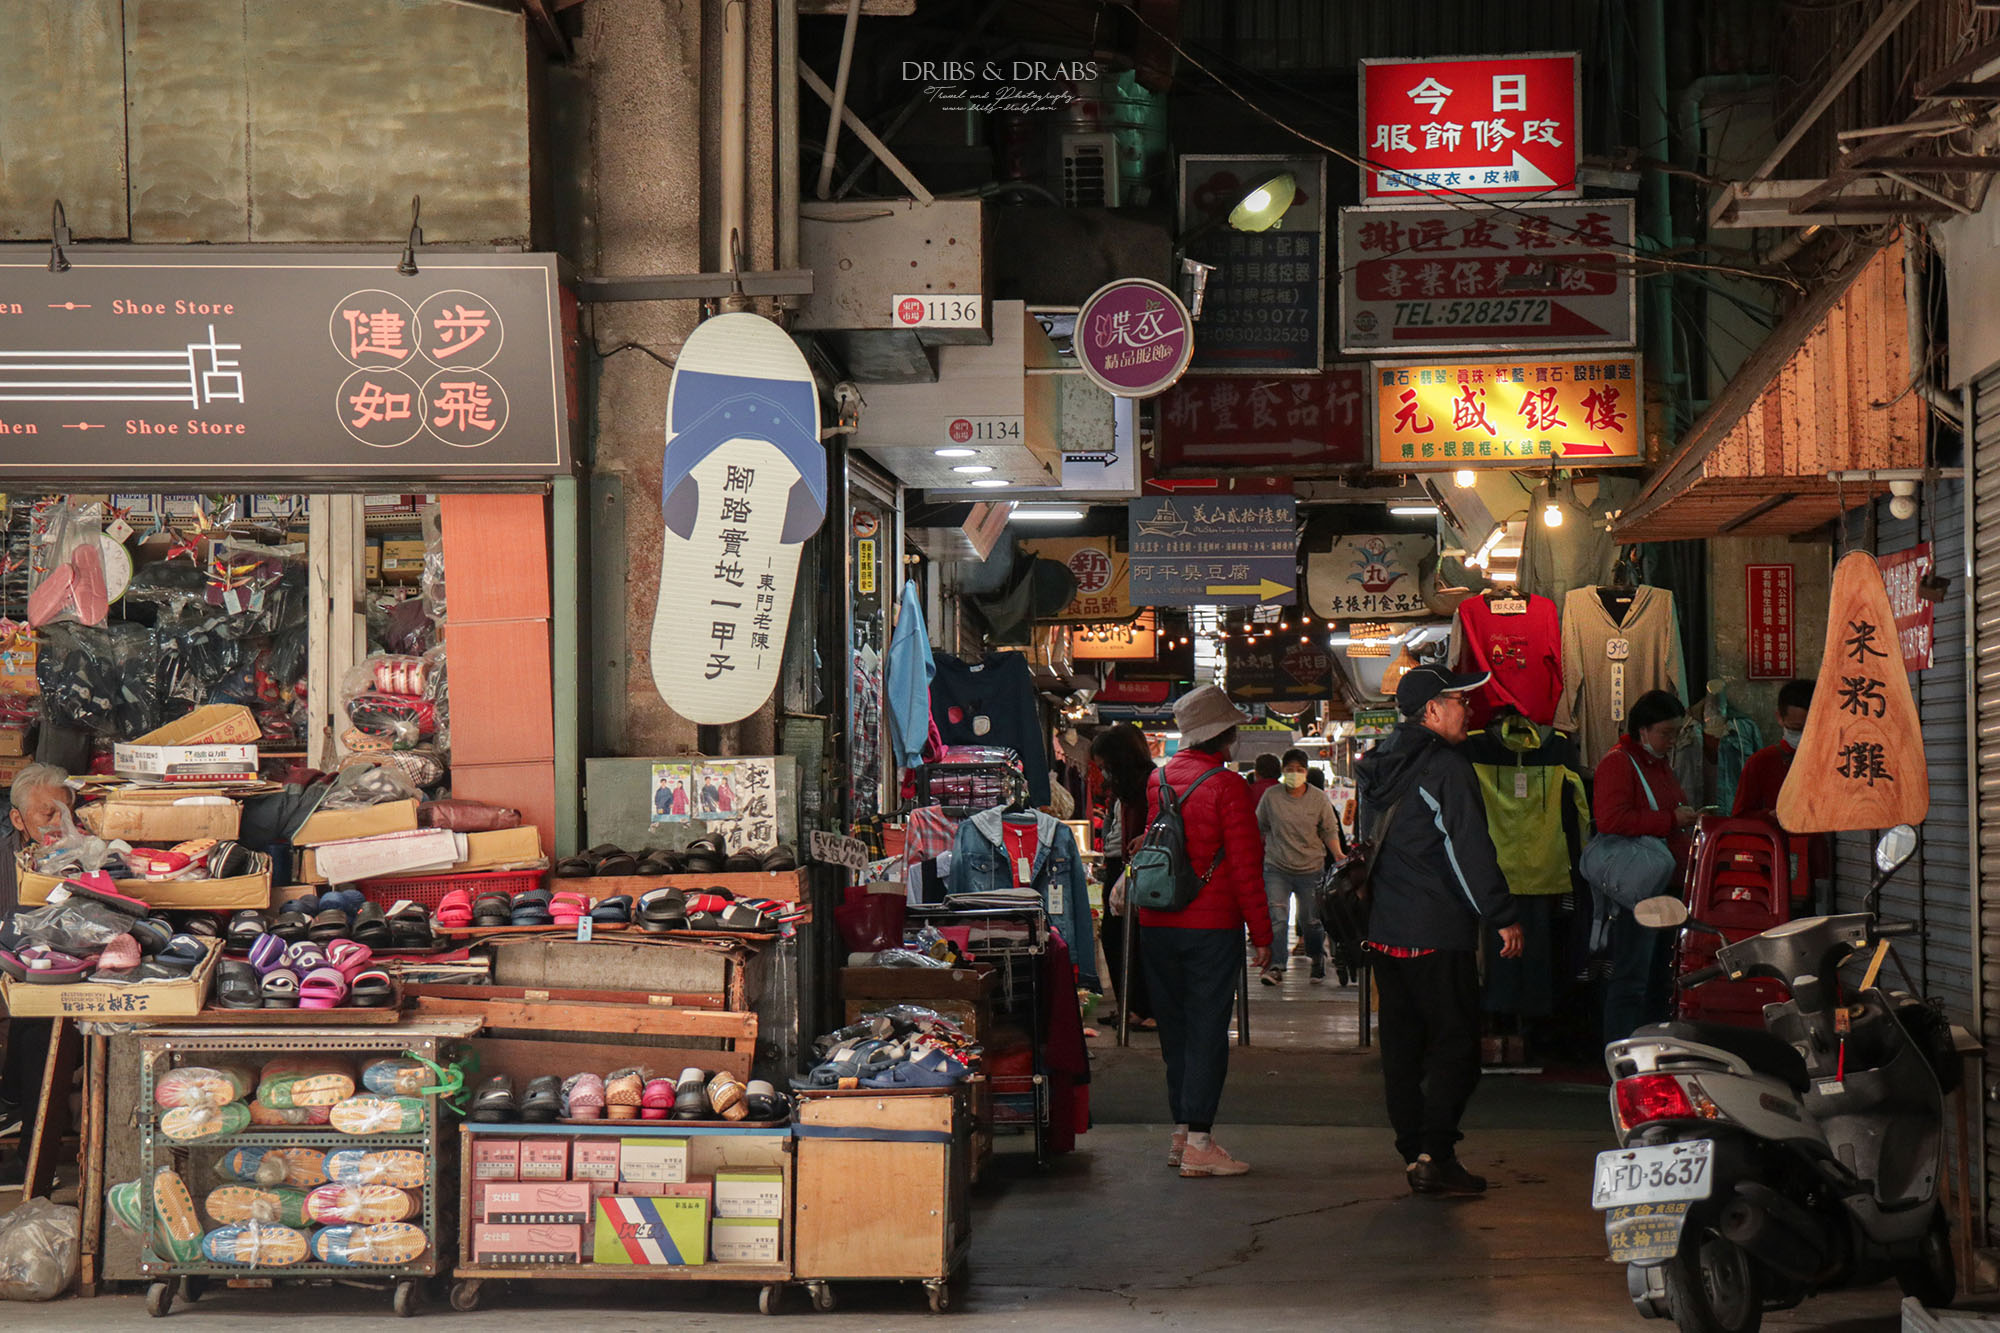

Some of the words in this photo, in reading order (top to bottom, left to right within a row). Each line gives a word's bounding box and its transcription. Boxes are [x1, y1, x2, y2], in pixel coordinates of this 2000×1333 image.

[1407, 74, 1527, 115] 今日
[1371, 119, 1563, 153] 服飾修改
[1358, 212, 1615, 253] 謝匠皮鞋店
[112, 300, 168, 315] Shoe
[174, 300, 234, 315] Store
[928, 302, 977, 321] 1136
[1393, 300, 1549, 326] TEL:5282572
[1393, 384, 1628, 436] 元盛銀樓
[126, 420, 179, 435] Shoe
[187, 420, 246, 435] Store
[977, 421, 1020, 439] 1134
[703, 465, 756, 681] 腳踏實地一甲子
[1366, 565, 1386, 583] 丸
[750, 573, 777, 650] 東門老陳
[1607, 640, 1628, 656] 390
